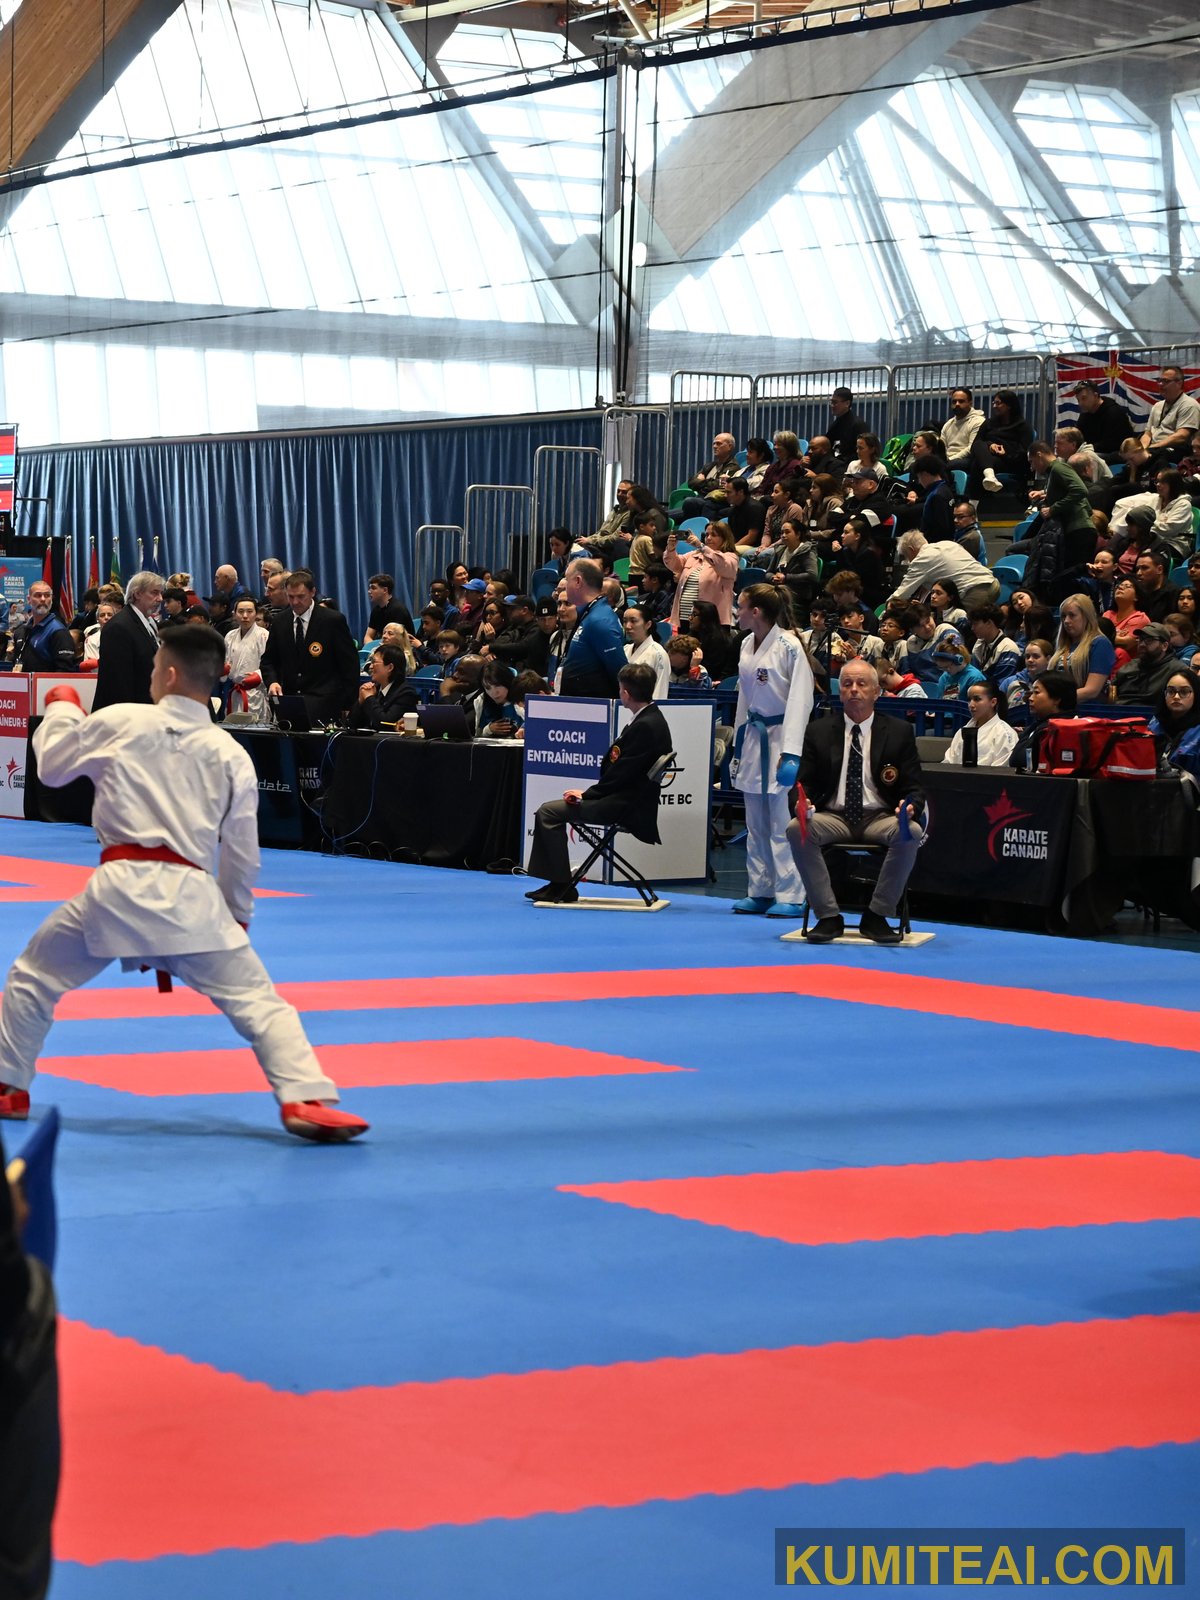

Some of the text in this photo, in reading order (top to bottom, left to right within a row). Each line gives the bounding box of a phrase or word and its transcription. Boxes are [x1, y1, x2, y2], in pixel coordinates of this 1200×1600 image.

[548, 730, 586, 744] COACH
[299, 768, 318, 778] RATE
[258, 779, 292, 792] data
[677, 794, 692, 805] BC
[1003, 828, 1048, 844] KARATE
[1002, 844, 1048, 860] CANADA
